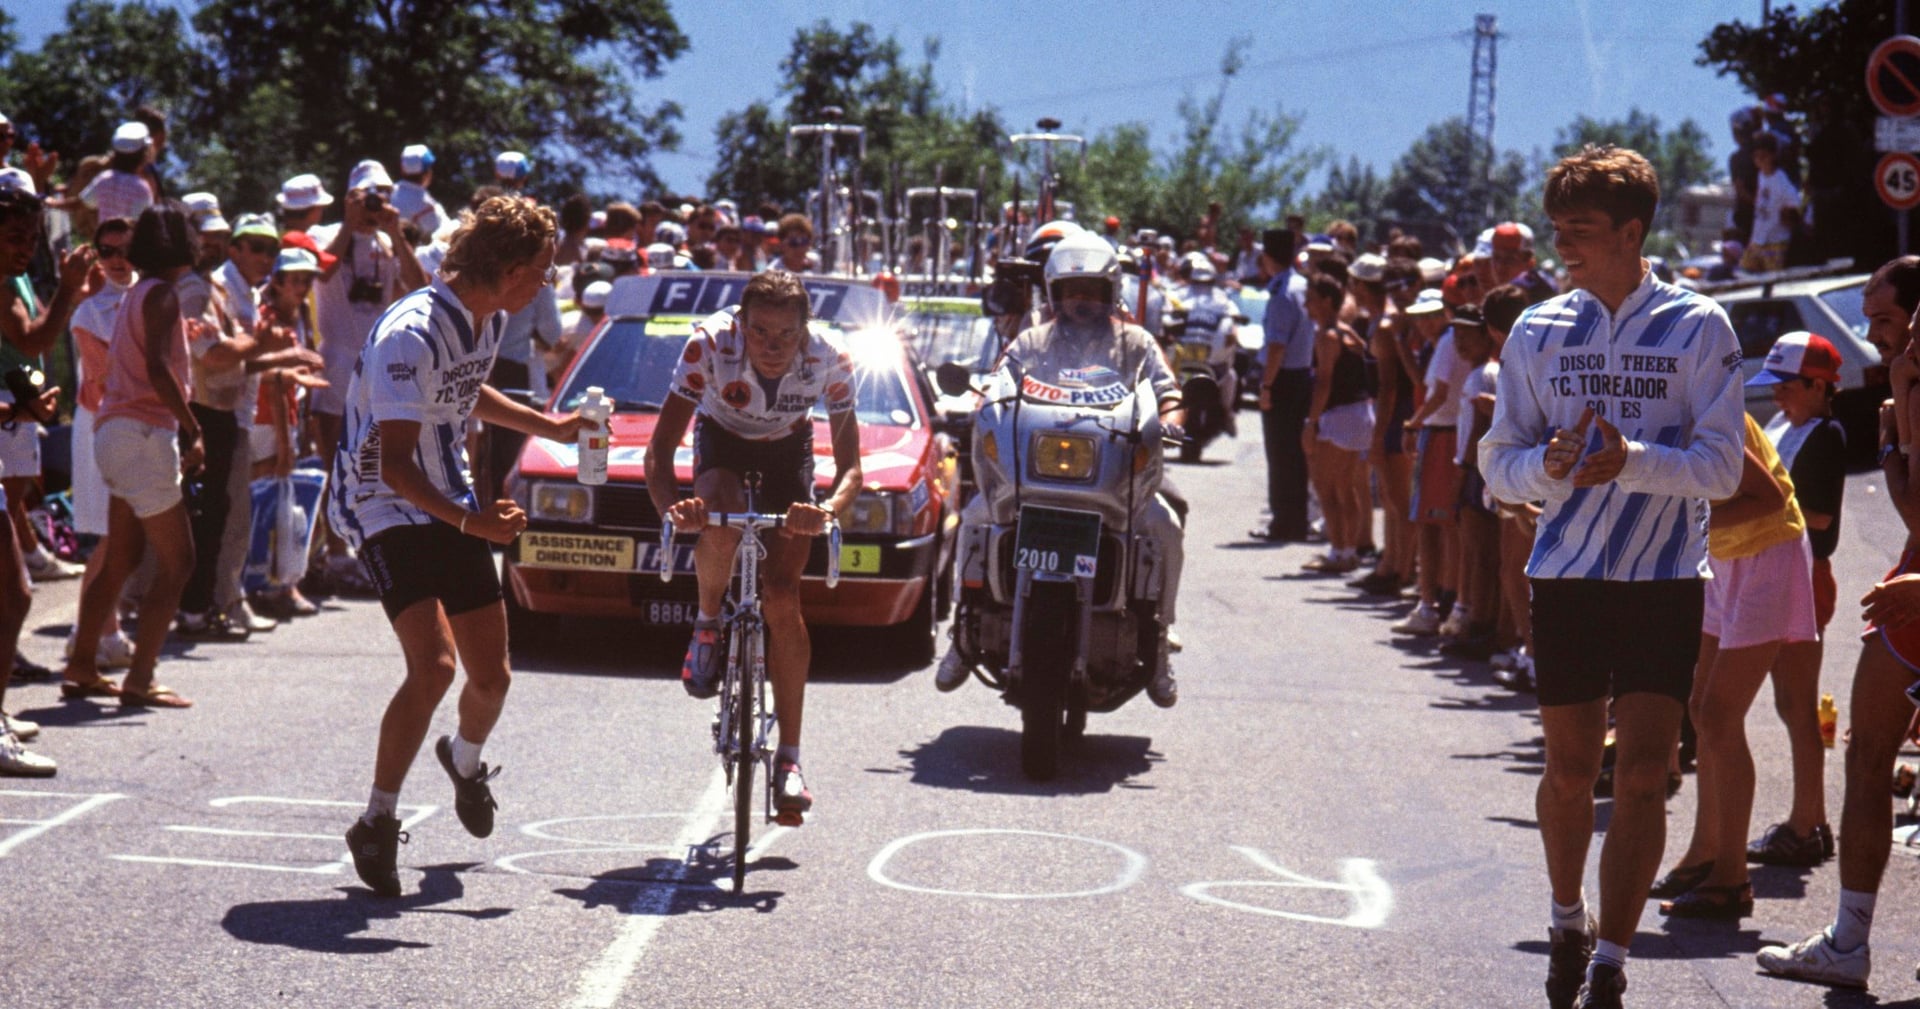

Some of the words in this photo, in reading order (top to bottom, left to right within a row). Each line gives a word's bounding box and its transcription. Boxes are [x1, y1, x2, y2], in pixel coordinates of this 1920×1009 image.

[1886, 168, 1916, 192] 45
[663, 282, 837, 312] FIT
[1559, 353, 1605, 372] DISCO
[1621, 356, 1679, 373] THEEK
[1550, 377, 1576, 397] TC.
[1579, 374, 1668, 399] TOREADOR
[1621, 401, 1642, 419] ES
[536, 550, 616, 567] DIRECTION
[852, 549, 862, 568] 3
[1017, 548, 1058, 570] 2010
[650, 603, 694, 624] 8884
